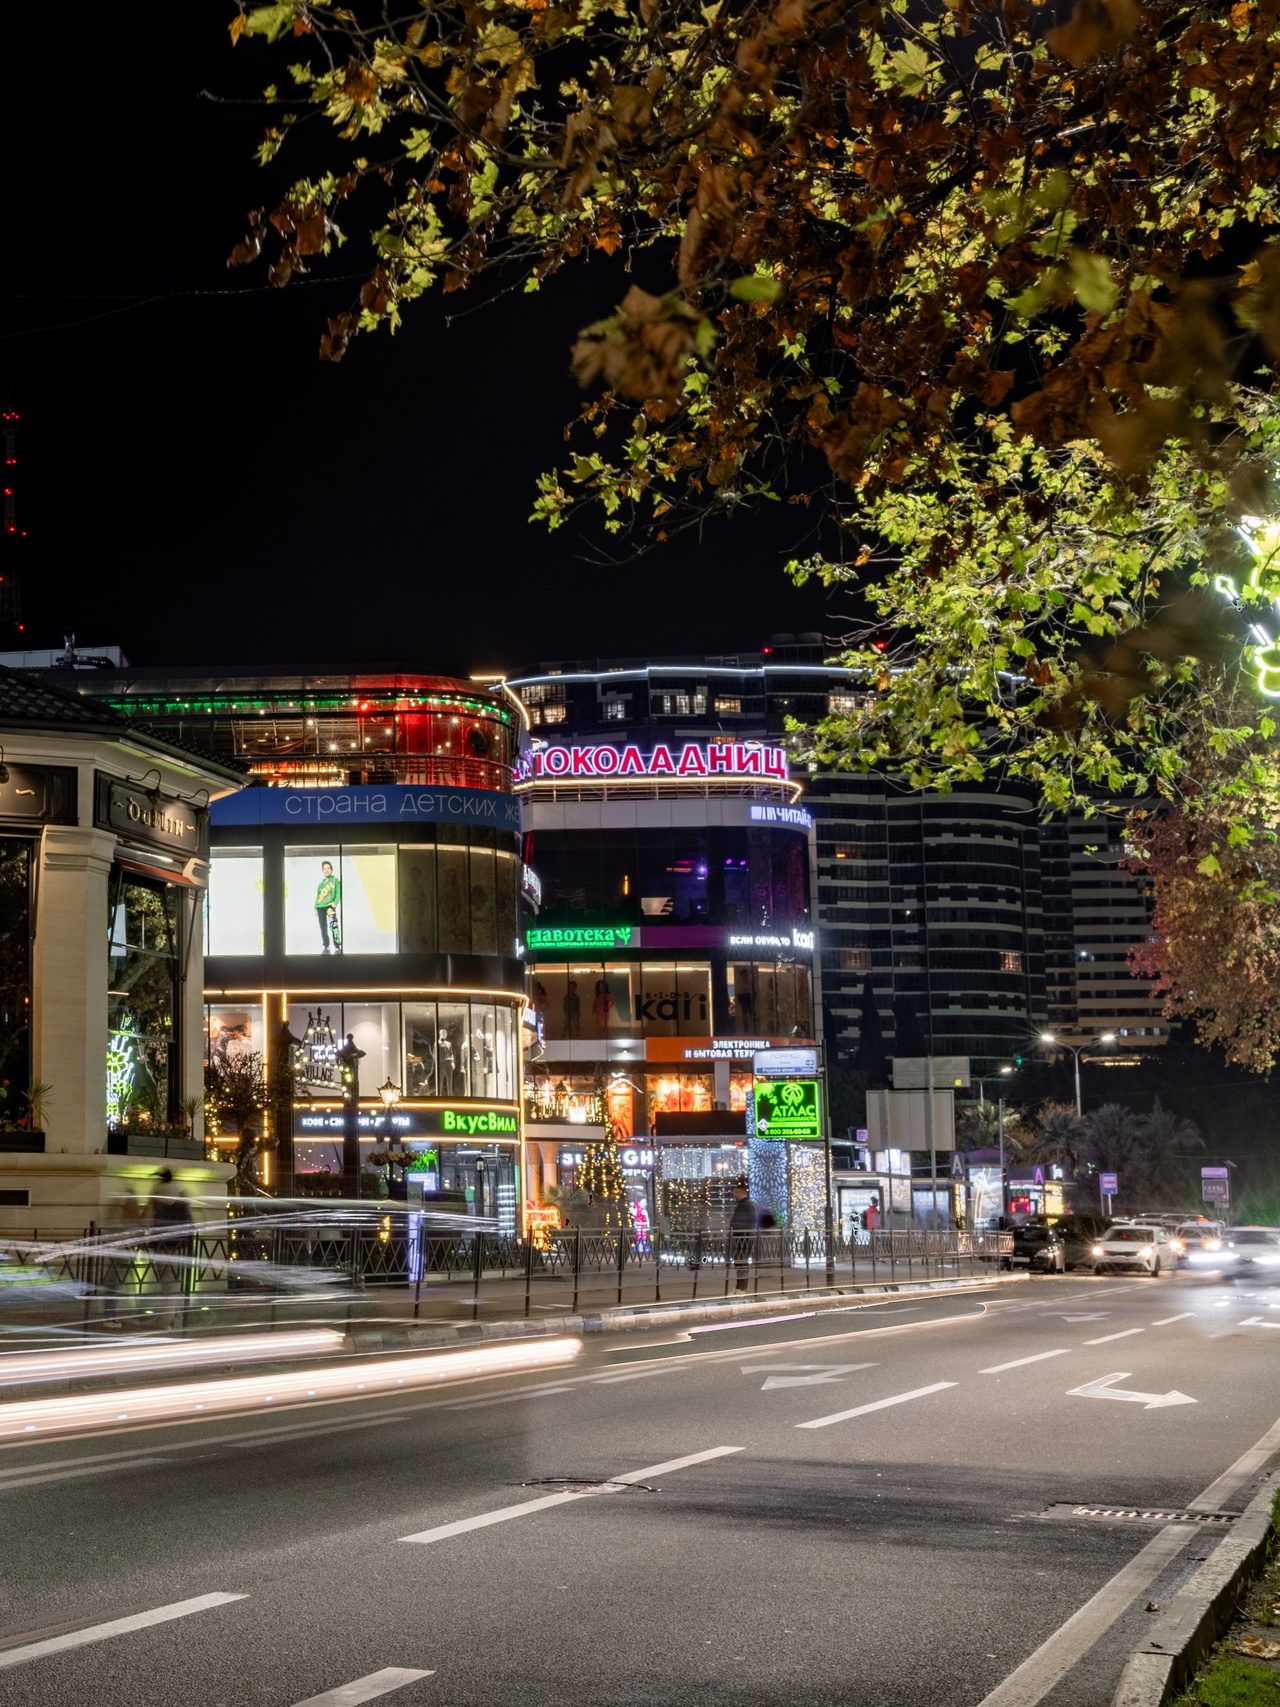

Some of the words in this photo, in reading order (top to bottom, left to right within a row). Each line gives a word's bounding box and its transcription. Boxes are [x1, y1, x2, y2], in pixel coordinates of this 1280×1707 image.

[532, 744, 790, 781] ОКОЛАДНИЦ
[285, 793, 387, 820] страна
[399, 793, 497, 818] детских
[635, 993, 707, 1020] kari
[712, 1040, 771, 1049] ЭЛЕКТРОНИКА
[685, 1050, 692, 1059] И
[693, 1050, 733, 1059] БЫТОВАЯ
[772, 1105, 816, 1117] АТЛАС
[302, 1117, 324, 1126] КОФЕ
[443, 1110, 517, 1135] ВкусВилл
